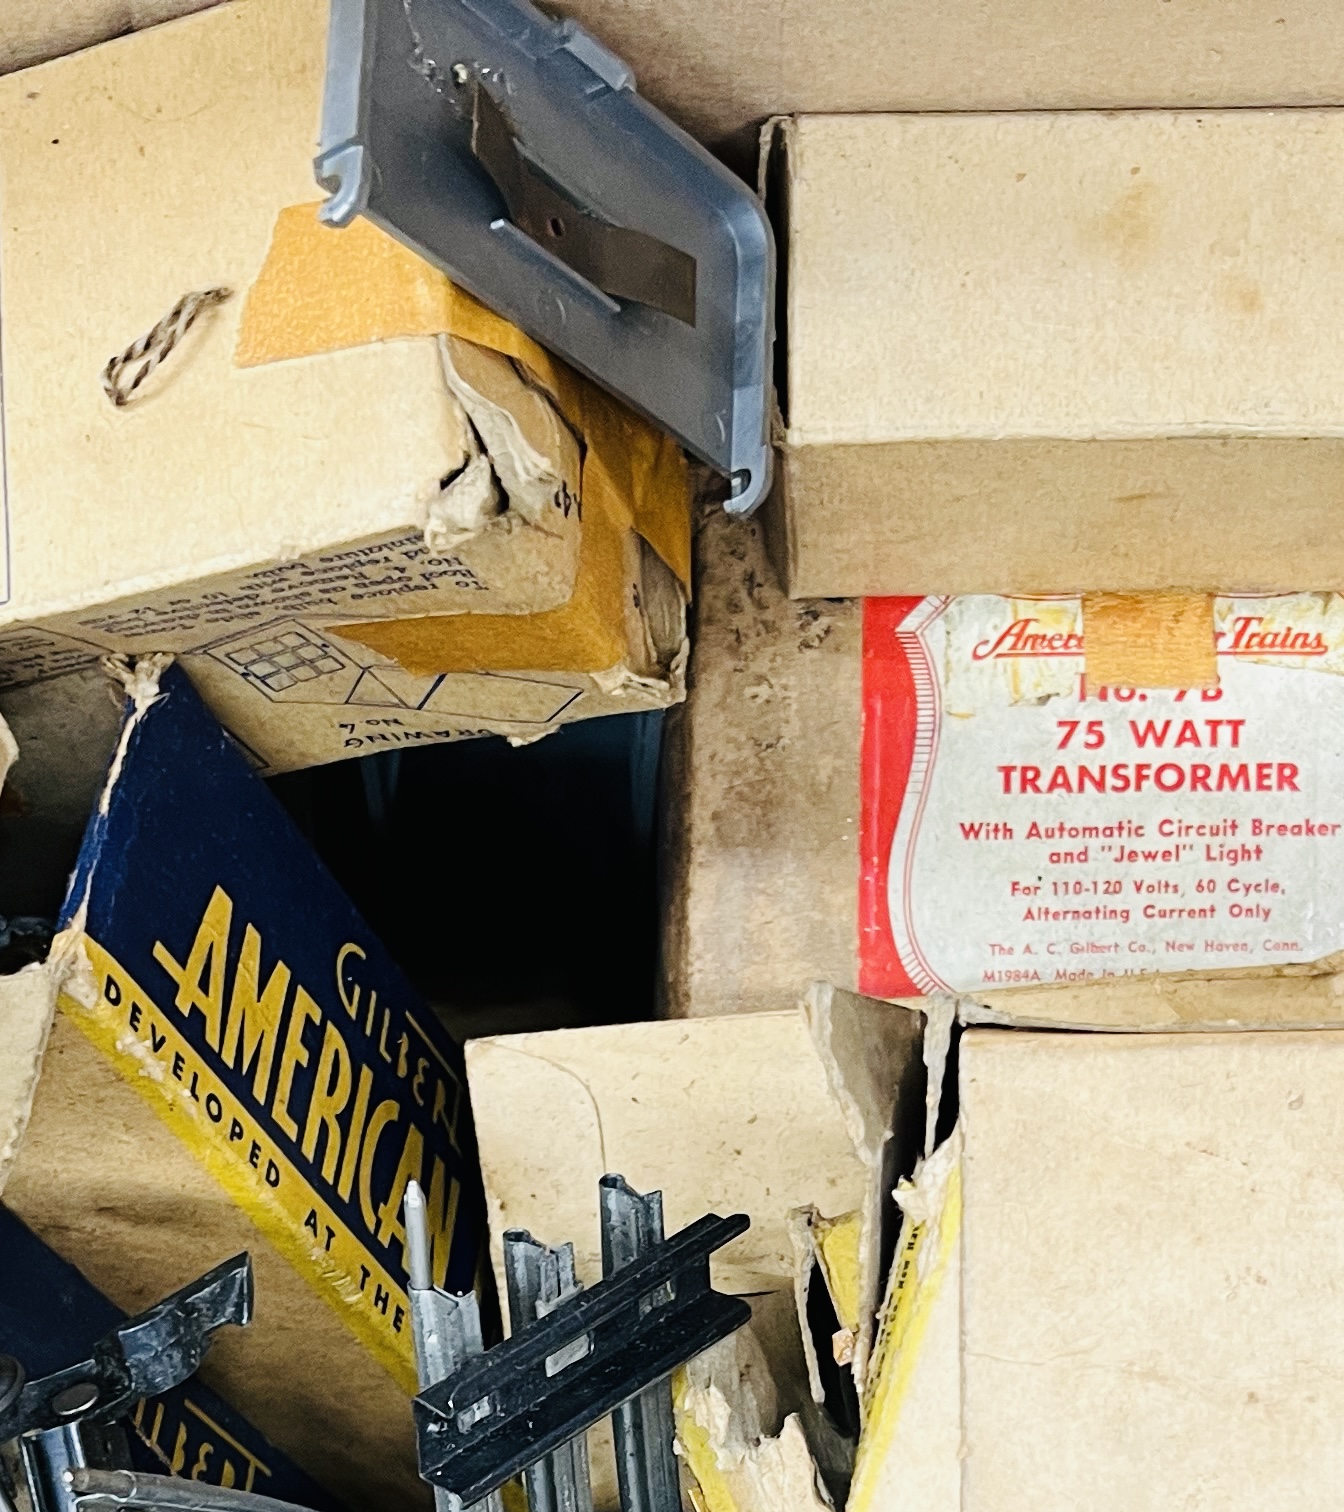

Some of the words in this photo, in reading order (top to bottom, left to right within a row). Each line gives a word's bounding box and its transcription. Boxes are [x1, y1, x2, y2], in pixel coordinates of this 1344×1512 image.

[1223, 616, 1329, 656] Trains
[1055, 719, 1106, 751] 75
[1129, 718, 1247, 750] WATT
[997, 762, 1301, 795] TRANSFORMER
[959, 821, 1015, 842] With
[1025, 819, 1146, 841] Automatic
[1158, 818, 1239, 839] Circuit
[1251, 818, 1342, 838] Breaker
[1048, 845, 1090, 865] and
[1100, 843, 1195, 864] "Jewel"
[1205, 843, 1264, 867] Light
[1010, 880, 1042, 898] For
[1051, 880, 1124, 897] 110-120
[1195, 879, 1217, 895] 60
[1022, 904, 1131, 924] Alternating
[1143, 903, 1217, 921] Current
[1228, 903, 1272, 923] Only
[989, 943, 1015, 957] The
[1022, 942, 1039, 956] A.
[1046, 941, 1063, 956] C.
[1069, 940, 1121, 956] Gilbert
[1164, 940, 1196, 954] New
[1204, 939, 1255, 955] Haven,
[1262, 939, 1304, 953] Conn.
[335, 941, 464, 1159] GILBERT
[152, 884, 462, 1292] AMERICAN
[104, 972, 282, 1190] DEVELOPED
[303, 1208, 336, 1256] AT
[357, 1263, 405, 1338] THE
